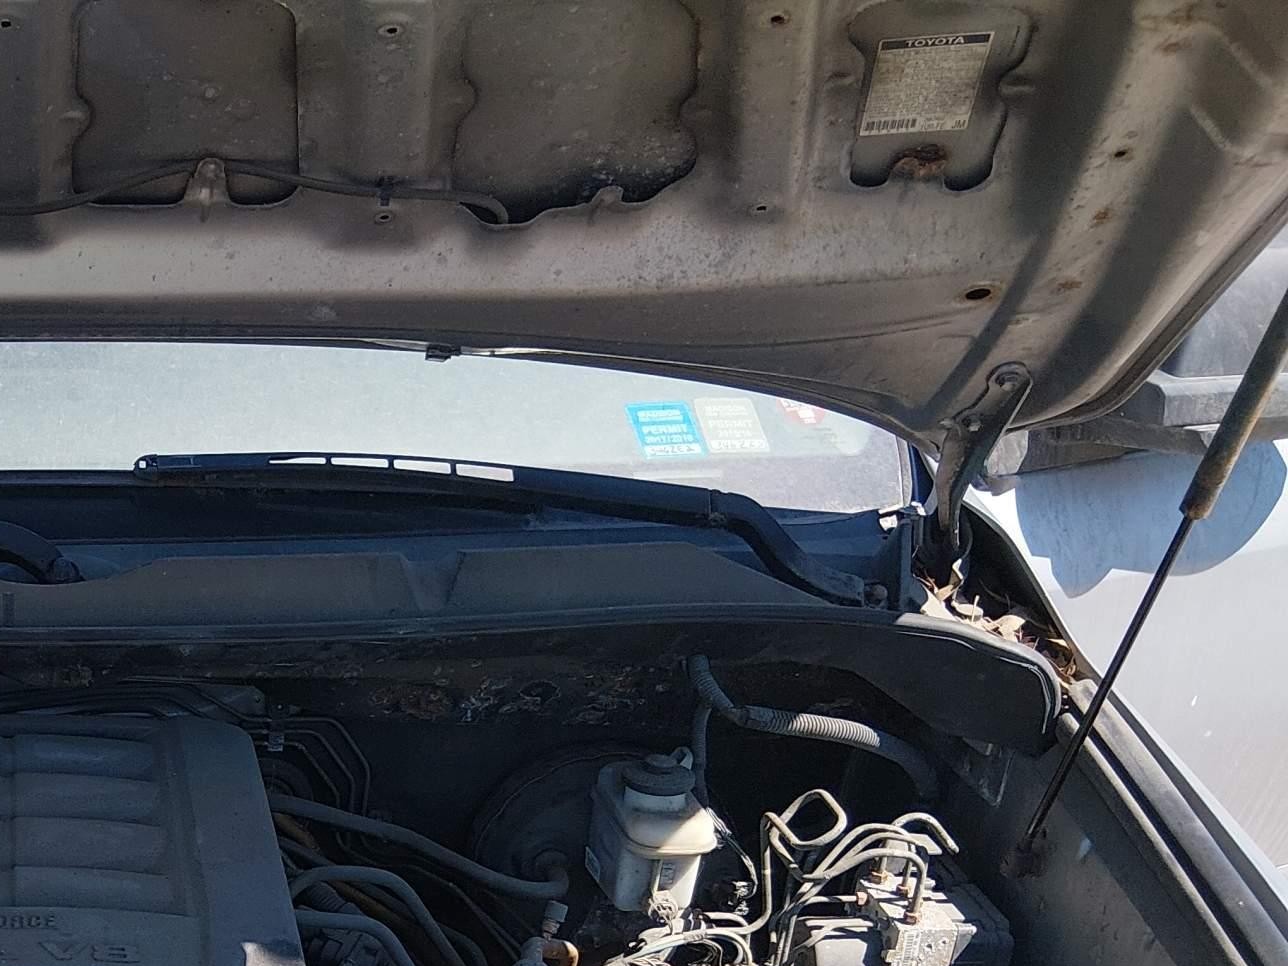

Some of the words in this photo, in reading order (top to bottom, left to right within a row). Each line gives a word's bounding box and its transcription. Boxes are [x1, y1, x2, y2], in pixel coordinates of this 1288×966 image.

[905, 36, 965, 48] TOYOTA
[642, 424, 688, 434] PERMIT
[37, 940, 141, 965] V8
